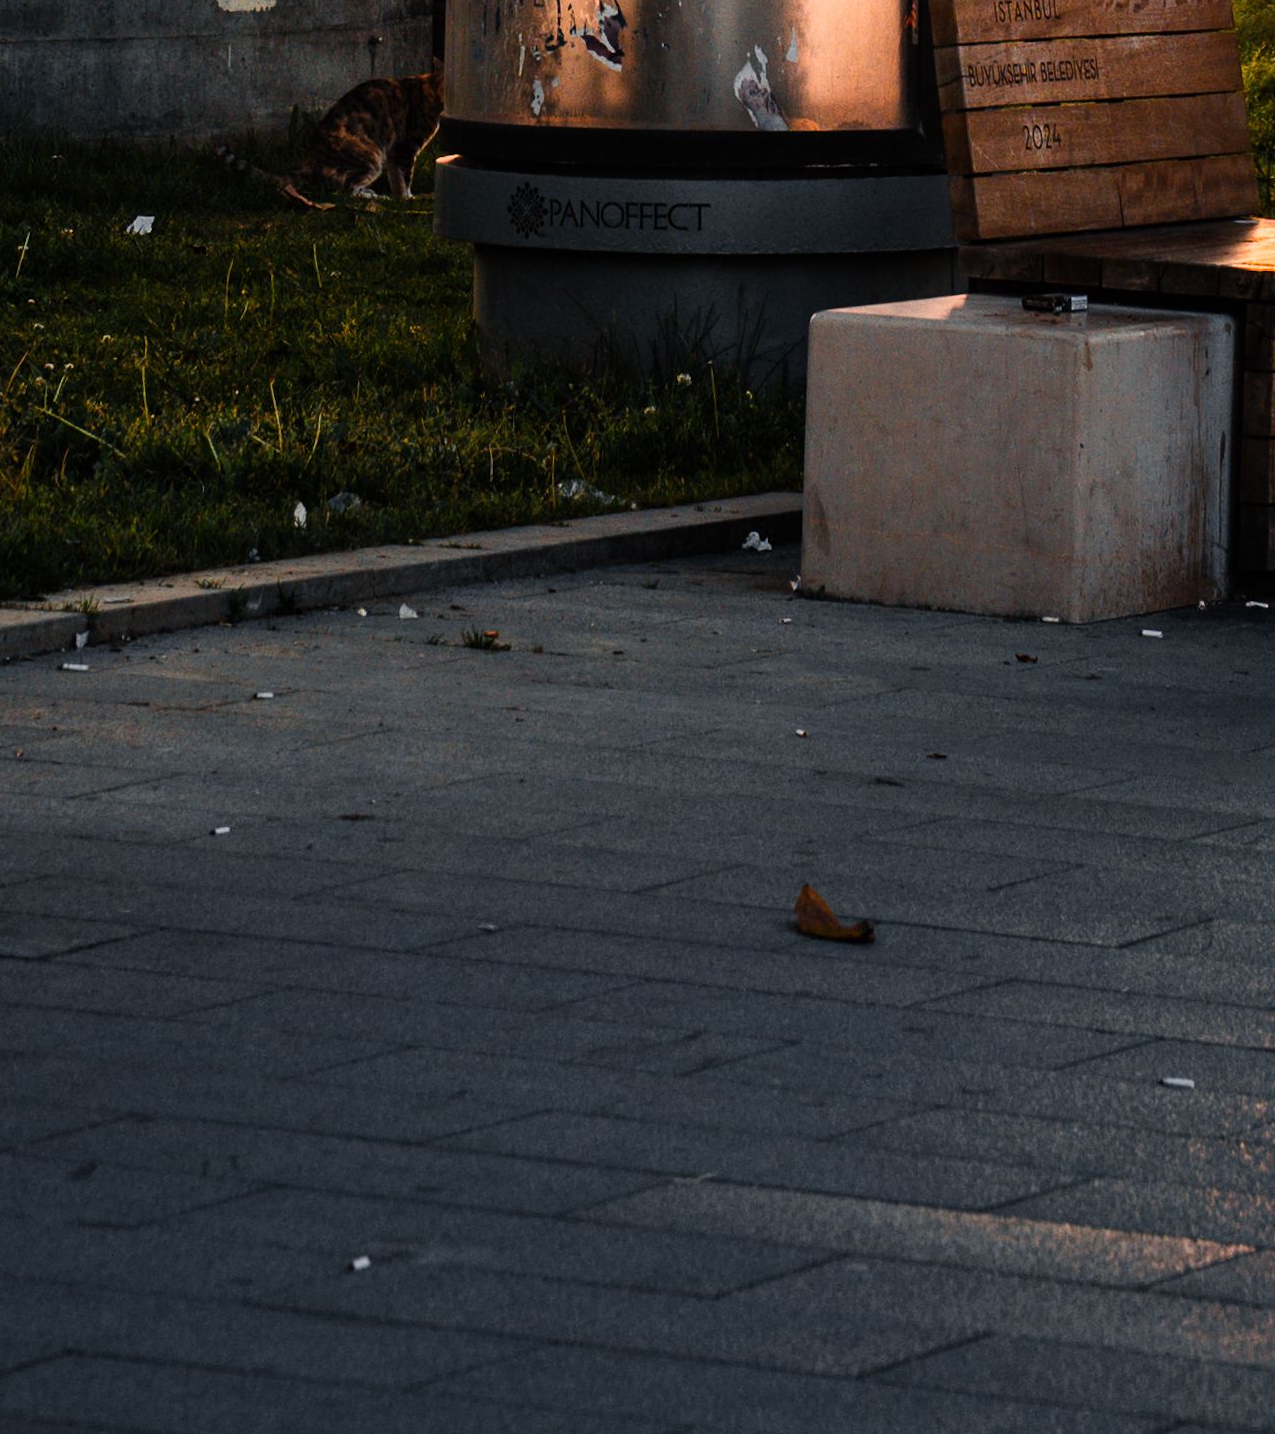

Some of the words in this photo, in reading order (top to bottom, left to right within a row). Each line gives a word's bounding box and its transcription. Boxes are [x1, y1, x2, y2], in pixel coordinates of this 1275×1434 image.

[968, 57, 1038, 87] BÜYÜKŞEHİR
[1040, 55, 1100, 82] BELEDİYESİ
[1022, 123, 1061, 151] 2024
[549, 199, 711, 231] PANOFFECT
